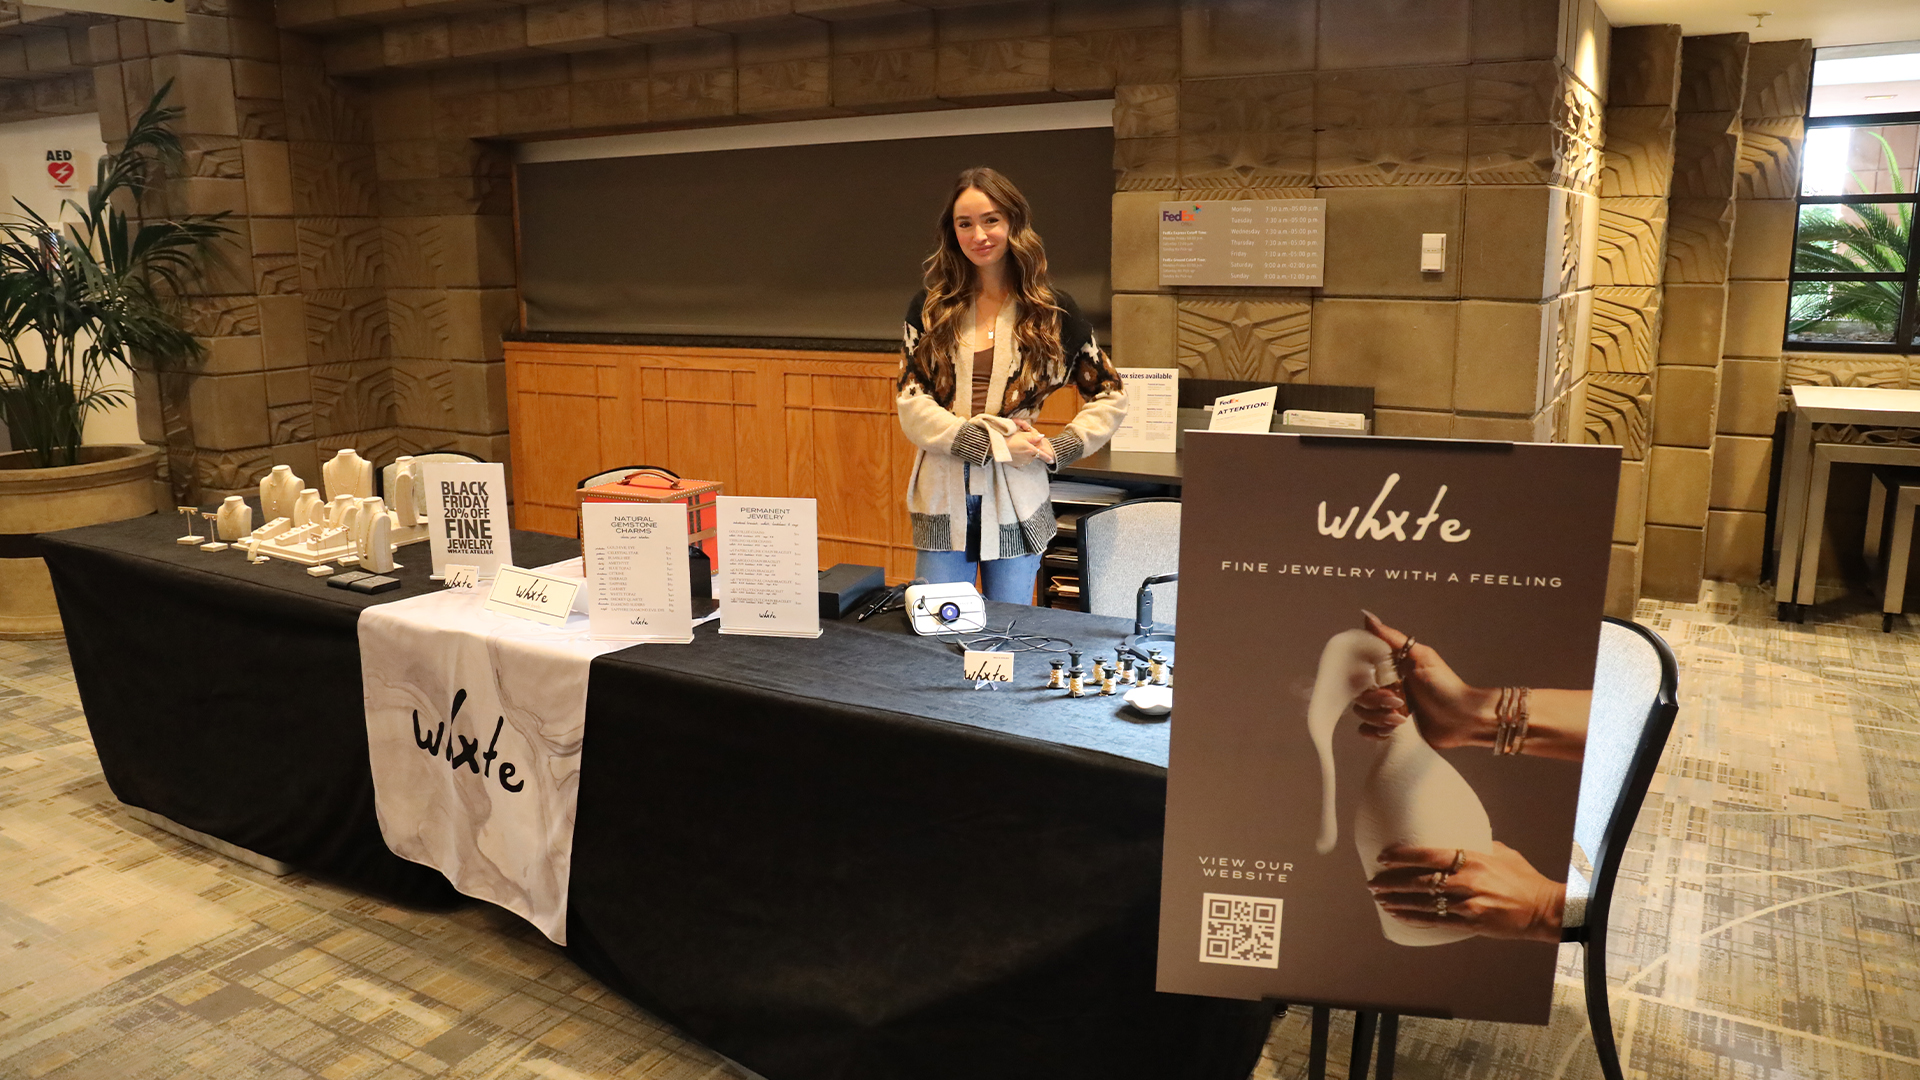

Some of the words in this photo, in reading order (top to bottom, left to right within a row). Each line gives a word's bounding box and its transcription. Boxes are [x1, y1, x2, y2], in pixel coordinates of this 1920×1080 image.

[46, 150, 72, 161] AED
[1162, 210, 1195, 222] FedEx
[1217, 401, 1269, 415] ATTENTION:
[1219, 398, 1240, 406] FedEx
[441, 481, 488, 496] BLACK
[442, 496, 489, 508] FRIDAY
[1316, 472, 1472, 543] whxte
[444, 508, 469, 518] 20%
[470, 508, 489, 518] OFF
[445, 519, 492, 539] FINE
[447, 539, 493, 550] JEWELRY
[1222, 561, 1268, 573] FINE
[1278, 564, 1376, 579] JEWELRY
[1385, 569, 1437, 581] WITH
[1448, 572, 1460, 582] A
[1470, 573, 1562, 588] FEELING
[516, 579, 548, 603] whxte
[964, 661, 1008, 682] whxte
[1199, 856, 1245, 867] VIEW
[1255, 860, 1294, 871] OUR
[1203, 868, 1287, 883] WEBSITE
